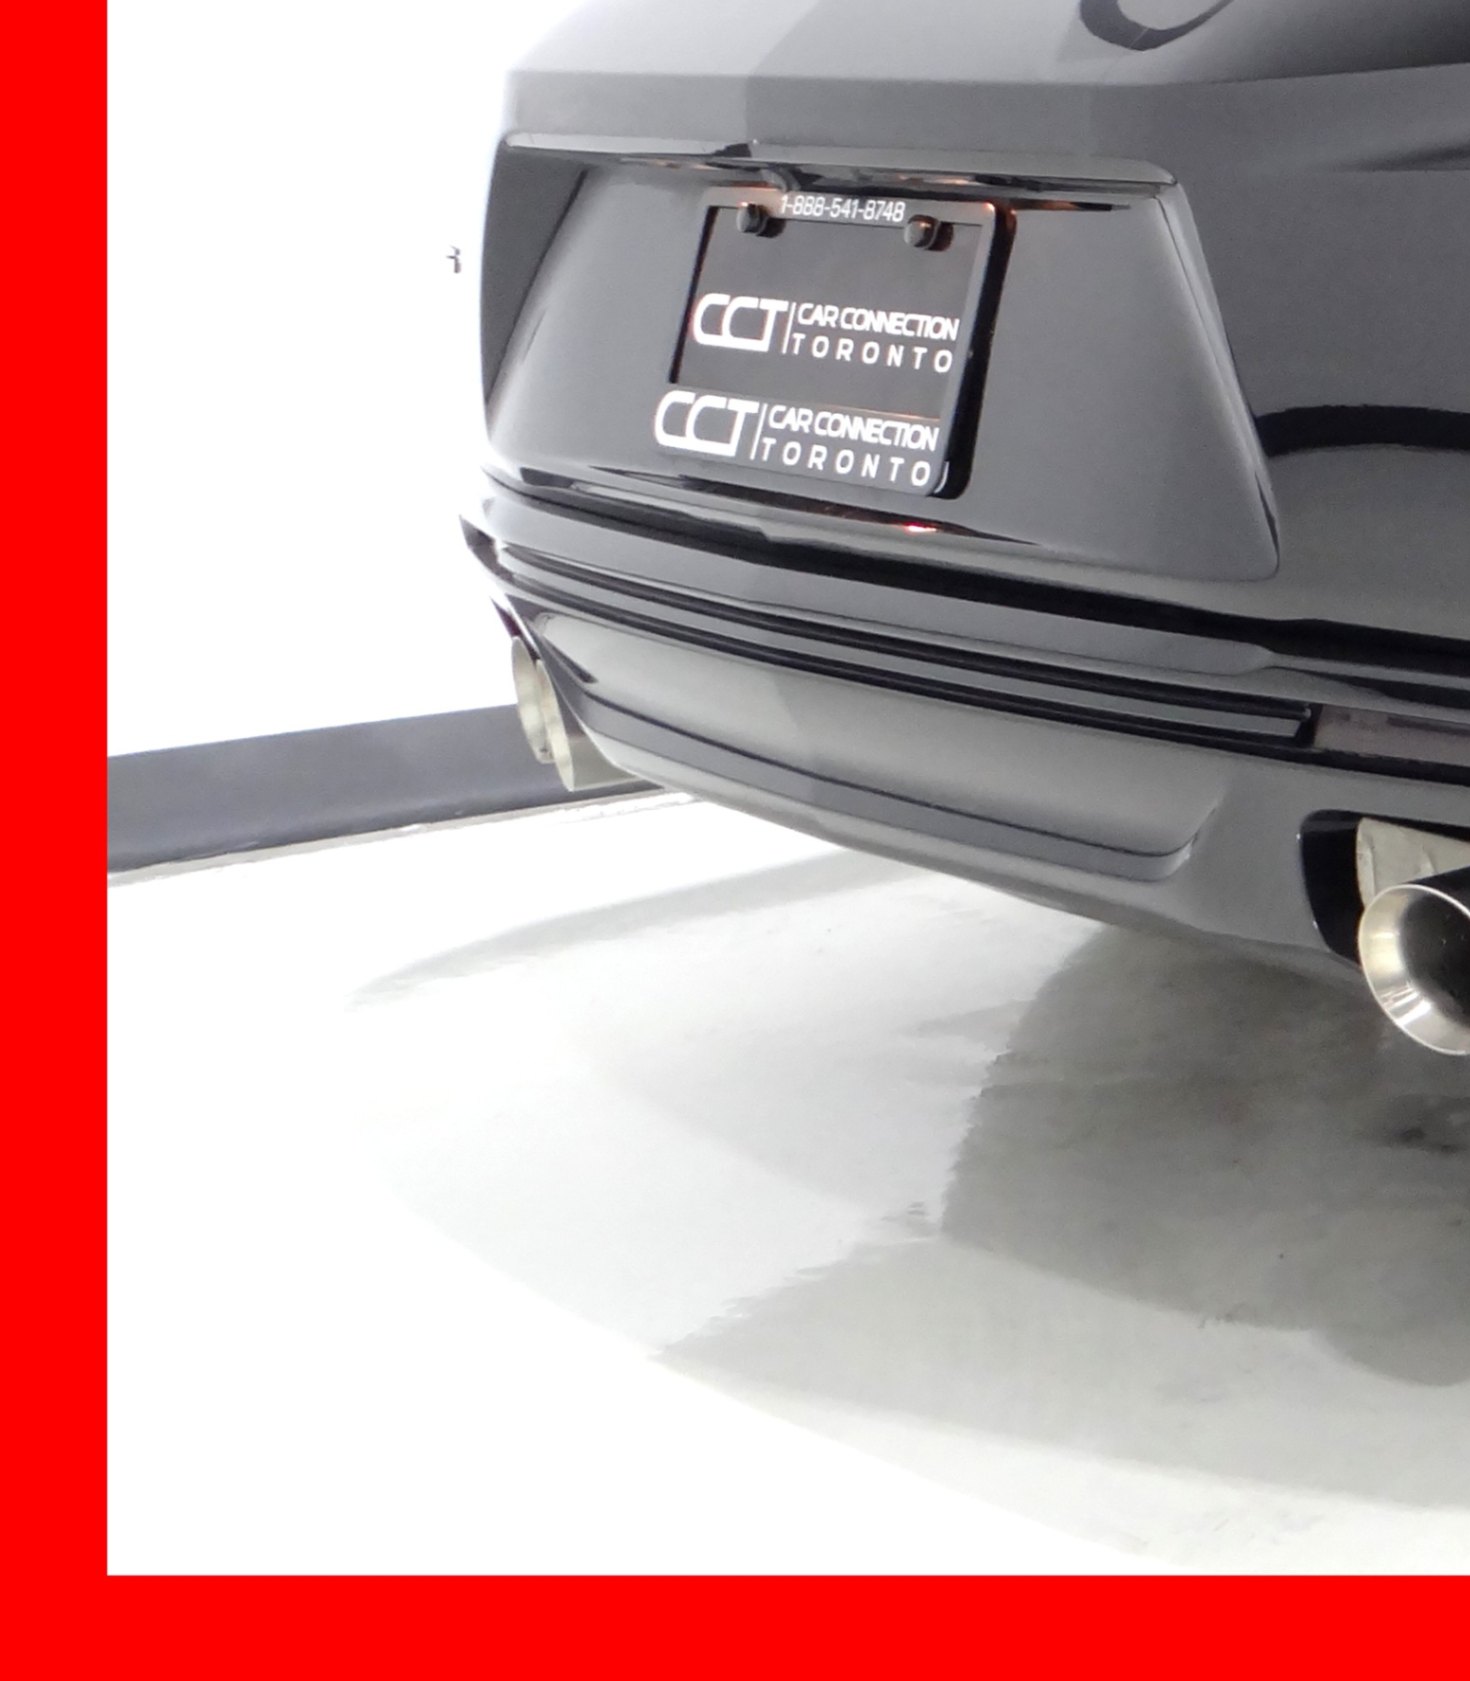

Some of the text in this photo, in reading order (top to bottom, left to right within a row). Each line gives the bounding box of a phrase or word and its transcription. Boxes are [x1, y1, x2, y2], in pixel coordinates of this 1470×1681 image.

[780, 194, 906, 223] 1-888-541-8748
[691, 292, 790, 353] CCT
[796, 302, 961, 342] CAR CONNECTION
[790, 332, 953, 374] TORONTO
[653, 389, 761, 458] CCT
[767, 404, 940, 452] CAR CONNECTION
[760, 436, 931, 487] TORONTO
